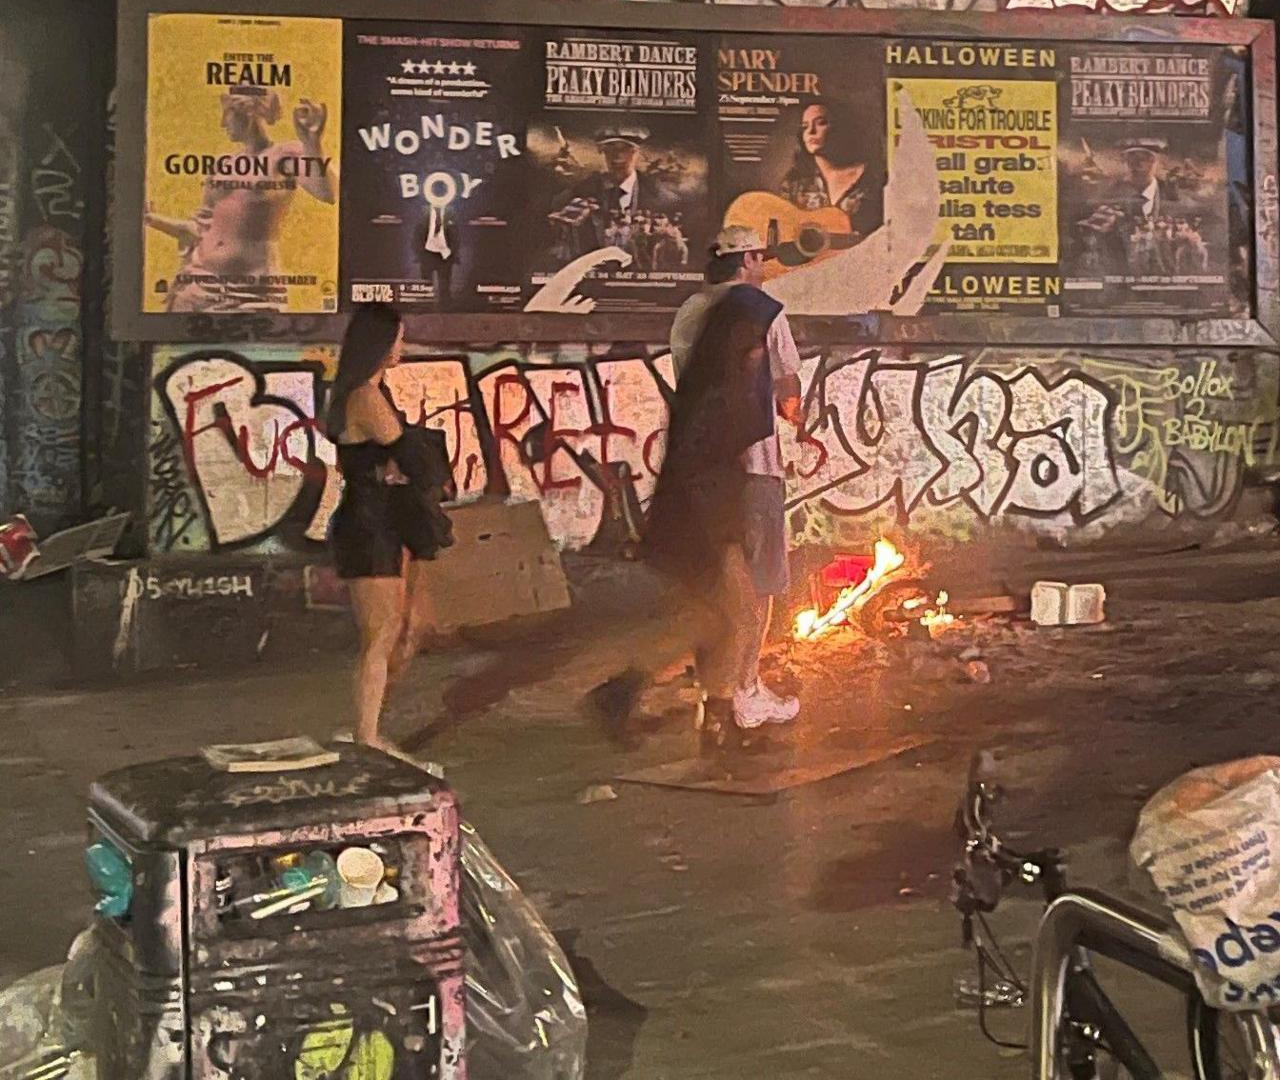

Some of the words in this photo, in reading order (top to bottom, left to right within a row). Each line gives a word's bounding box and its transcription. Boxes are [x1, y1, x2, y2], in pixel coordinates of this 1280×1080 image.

[545, 41, 634, 62] RAMBERT
[639, 45, 697, 64] DANCE
[718, 49, 780, 70] MARY
[886, 45, 1056, 68] HALLOWEEN
[206, 62, 292, 87] REALM
[1070, 56, 1150, 74] RAMBERT
[1156, 58, 1210, 76] DANCE
[545, 66, 606, 96] PEAKY
[608, 69, 697, 99] BLINDERS
[718, 71, 821, 96] SPENDER
[1071, 80, 1125, 107] PEAKY
[1128, 80, 1210, 109] BLINDERS
[894, 107, 955, 131] LKING
[958, 108, 988, 131] FOR
[990, 109, 1052, 132] TROUBLE
[357, 114, 521, 159] WONDER
[894, 134, 1052, 151] RISTOL
[164, 153, 268, 177] GORGON
[276, 155, 333, 178] CITY
[209, 179, 254, 191] SPECIAL
[399, 171, 483, 209] BOY
[983, 199, 1042, 219] tess
[259, 275, 317, 286] NOVEMBER
